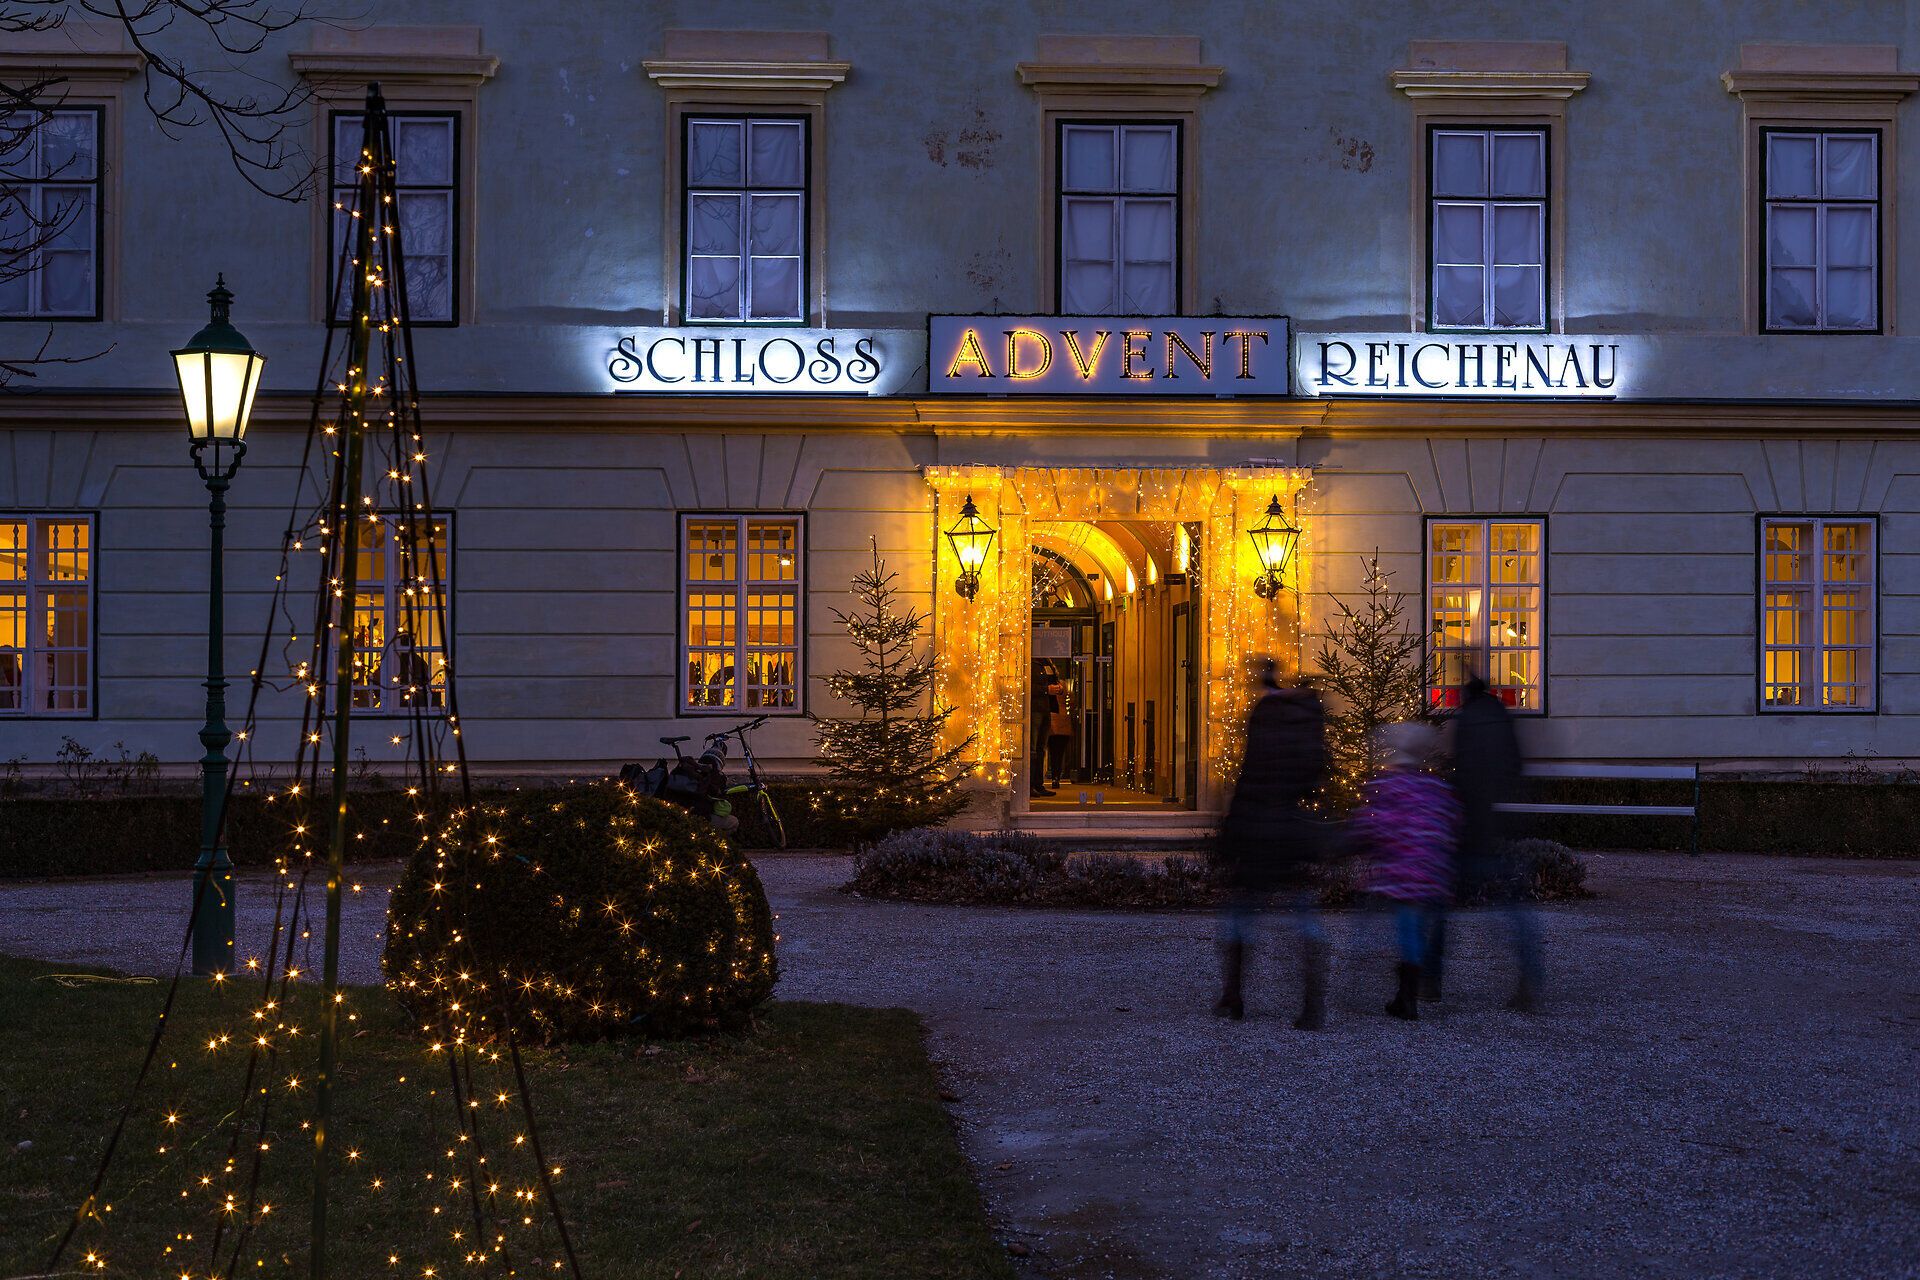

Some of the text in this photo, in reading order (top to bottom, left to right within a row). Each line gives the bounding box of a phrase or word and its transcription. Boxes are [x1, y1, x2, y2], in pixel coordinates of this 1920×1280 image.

[608, 329, 1620, 391] SCHLOSS ADVENT REICHENAU
